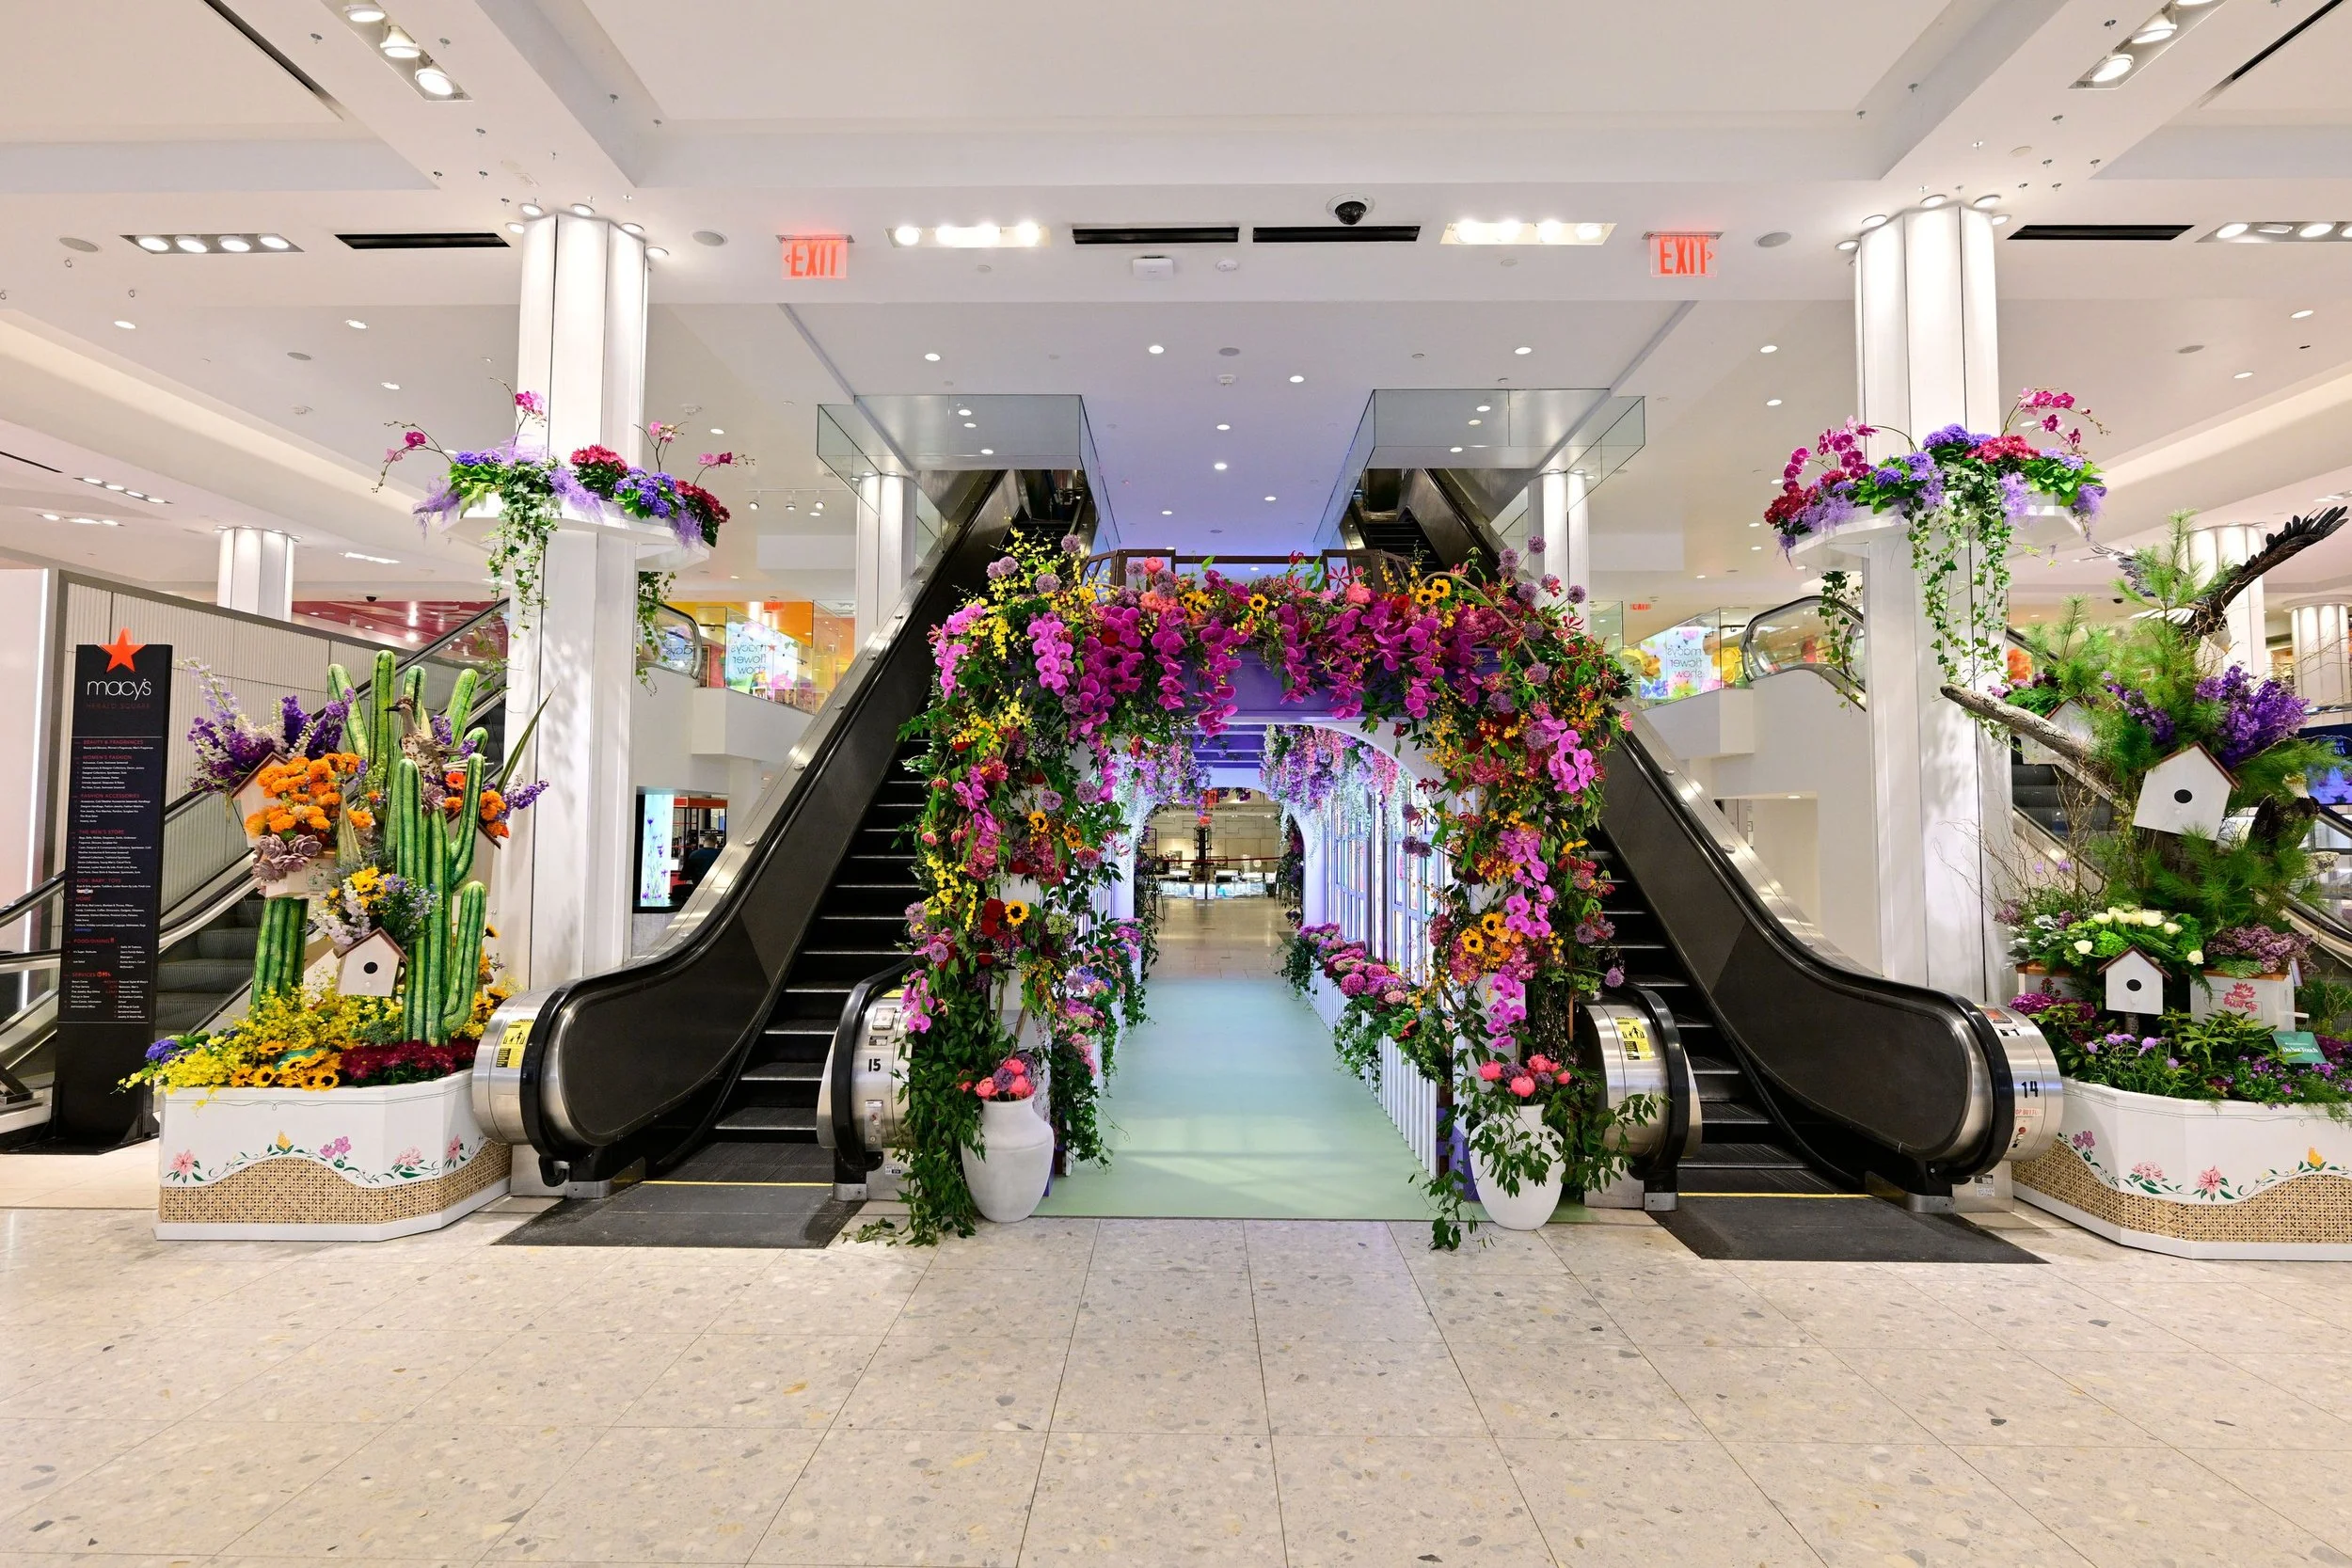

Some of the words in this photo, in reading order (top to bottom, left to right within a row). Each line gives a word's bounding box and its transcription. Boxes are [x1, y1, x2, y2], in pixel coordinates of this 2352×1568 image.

[790, 240, 839, 277] EXIT
[1659, 235, 1709, 275] EXIT
[87, 678, 151, 701] macy's
[867, 1058, 882, 1072] 15
[2021, 1080, 2039, 1099] 14
